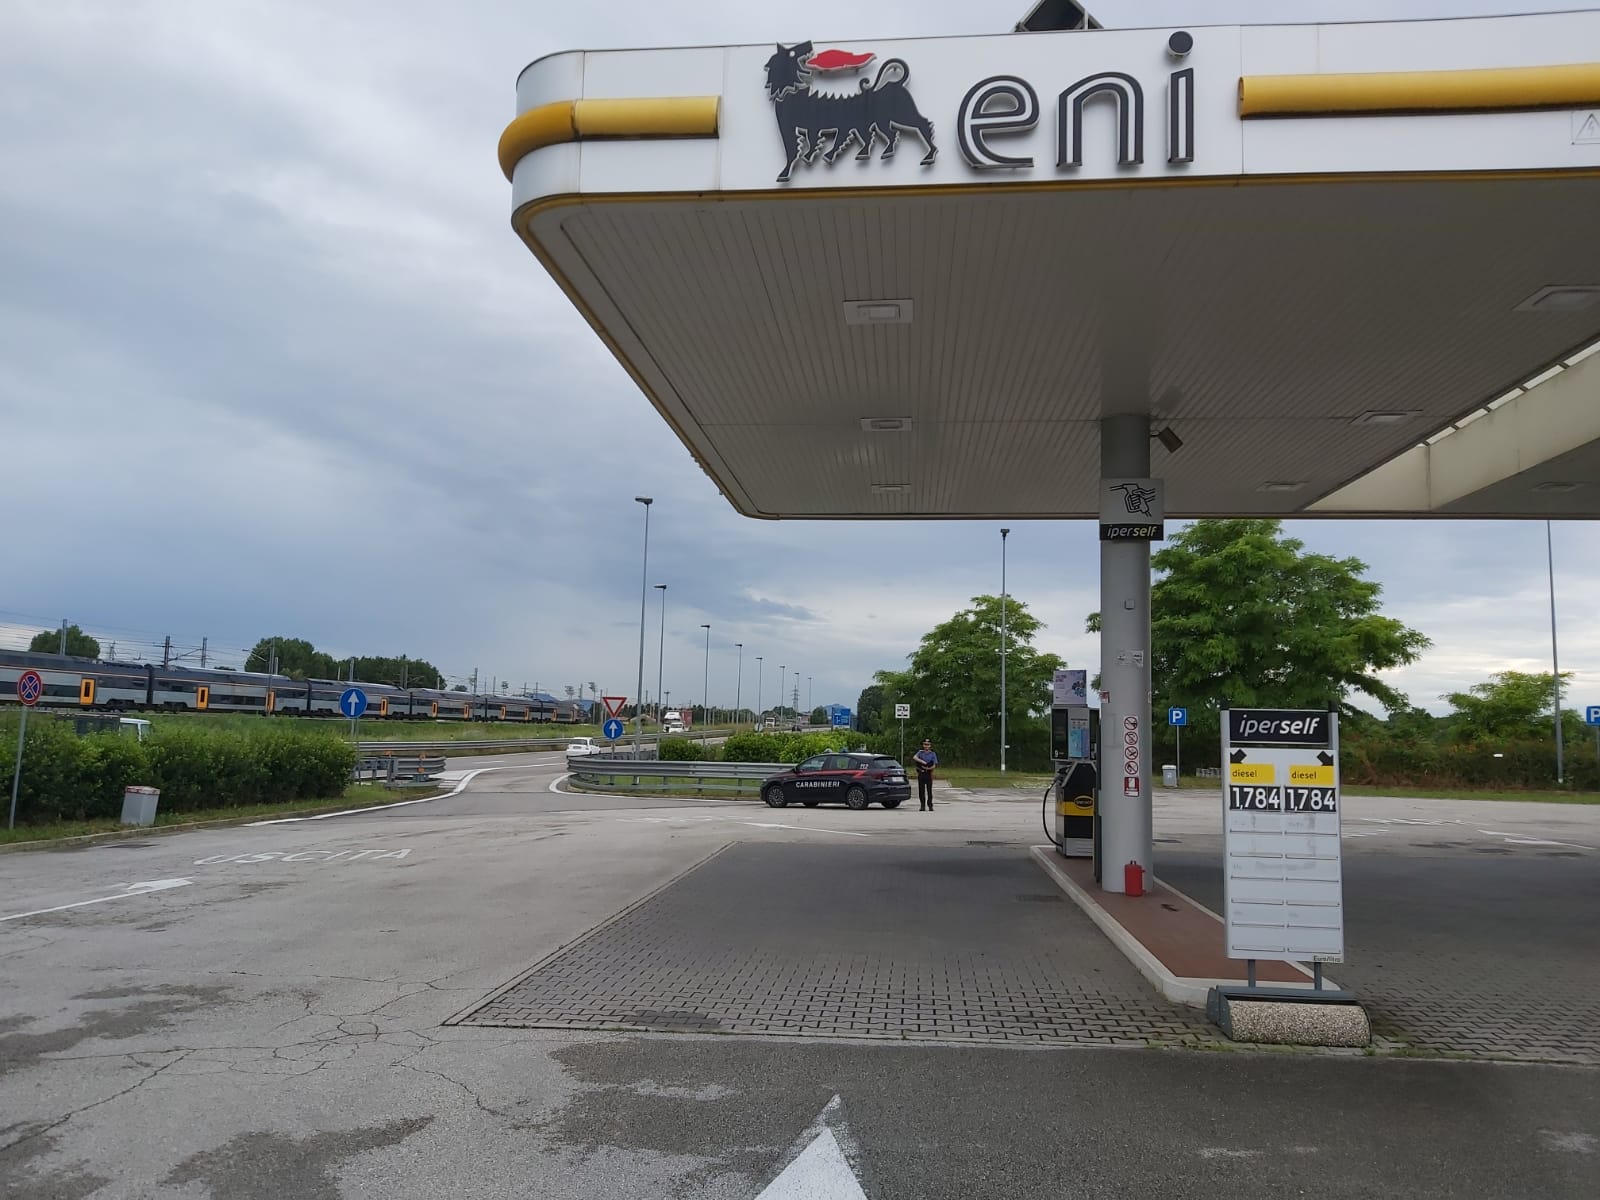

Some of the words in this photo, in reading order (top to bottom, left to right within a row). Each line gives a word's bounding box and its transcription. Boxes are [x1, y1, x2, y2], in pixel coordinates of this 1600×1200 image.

[957, 31, 1194, 168] eni
[1107, 524, 1157, 539] iperself
[1172, 710, 1183, 723] P
[1239, 714, 1320, 737] iperself
[1232, 769, 1257, 778] diesel
[1291, 770, 1317, 779] diesel
[795, 781, 840, 789] CARABINIERI
[1232, 787, 1280, 810] 1,784
[1287, 788, 1335, 812] 1,784
[193, 849, 412, 865] USCITA
